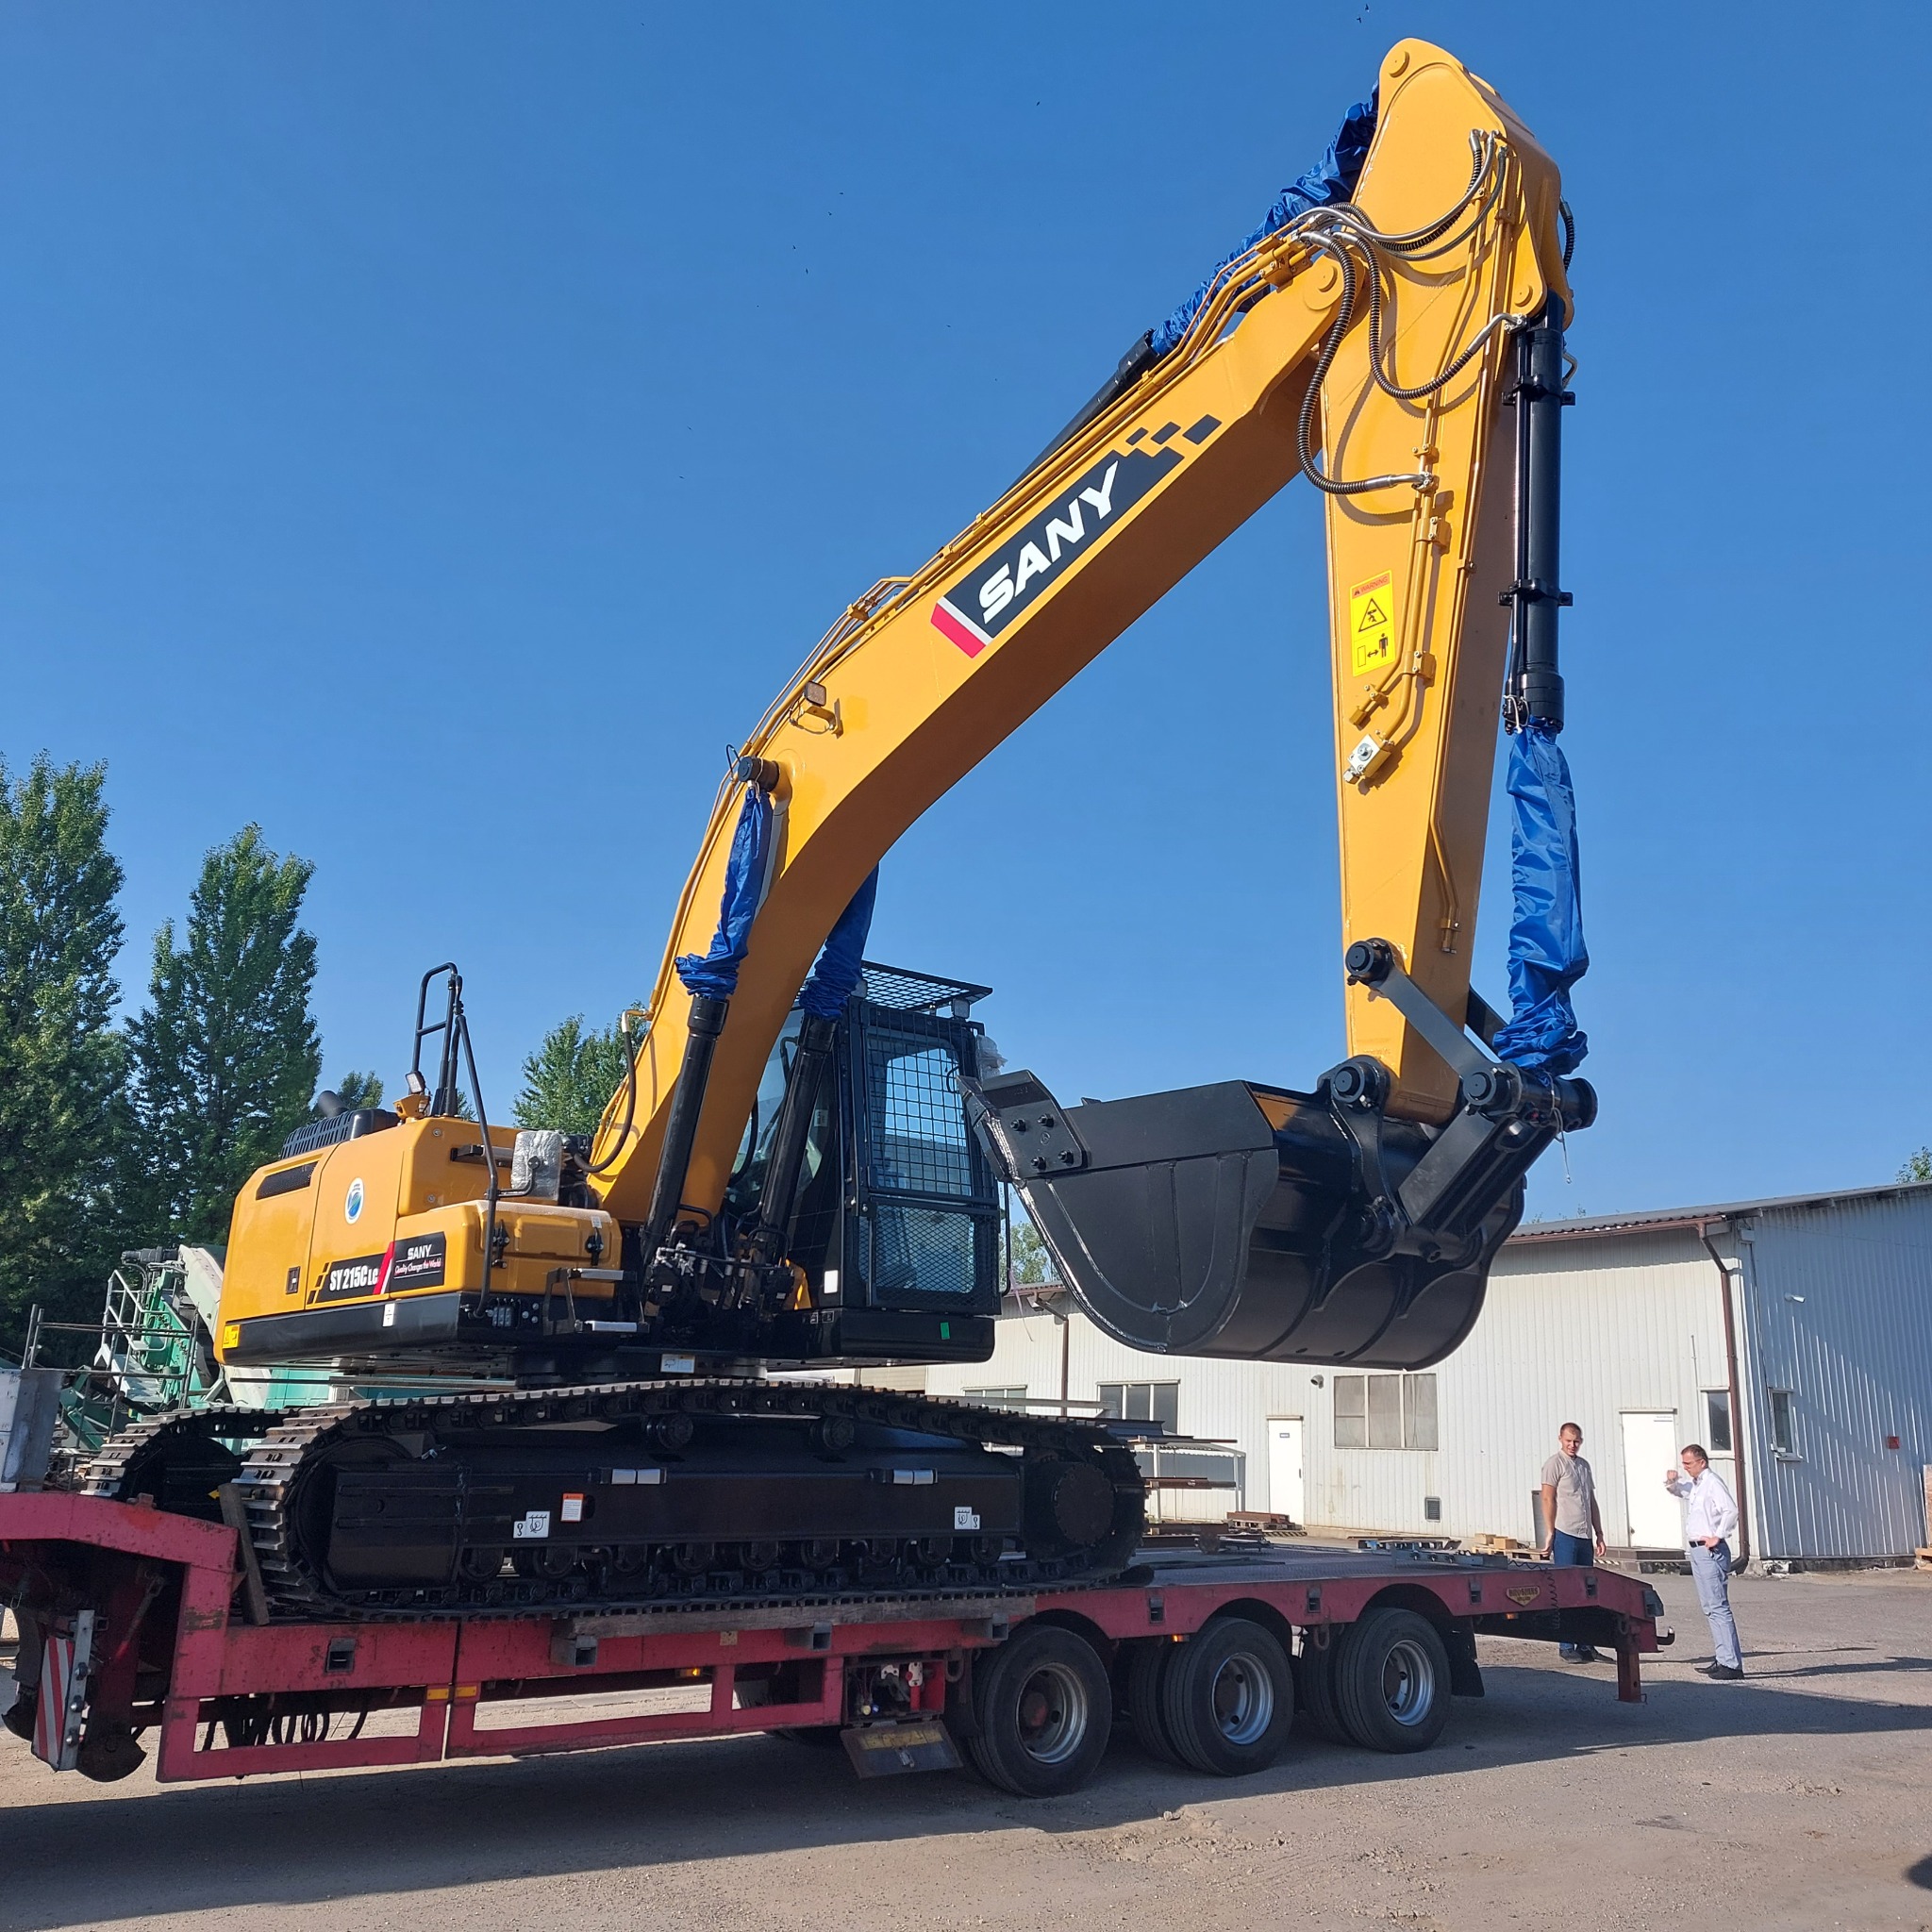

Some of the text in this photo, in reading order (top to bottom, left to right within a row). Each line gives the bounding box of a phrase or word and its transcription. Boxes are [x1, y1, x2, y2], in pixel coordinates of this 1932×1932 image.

[978, 459, 1119, 625] SANY
[407, 1244, 432, 1260] SANY
[394, 1264, 408, 1275] Quality
[408, 1262, 423, 1273] Changes
[429, 1257, 441, 1268] World
